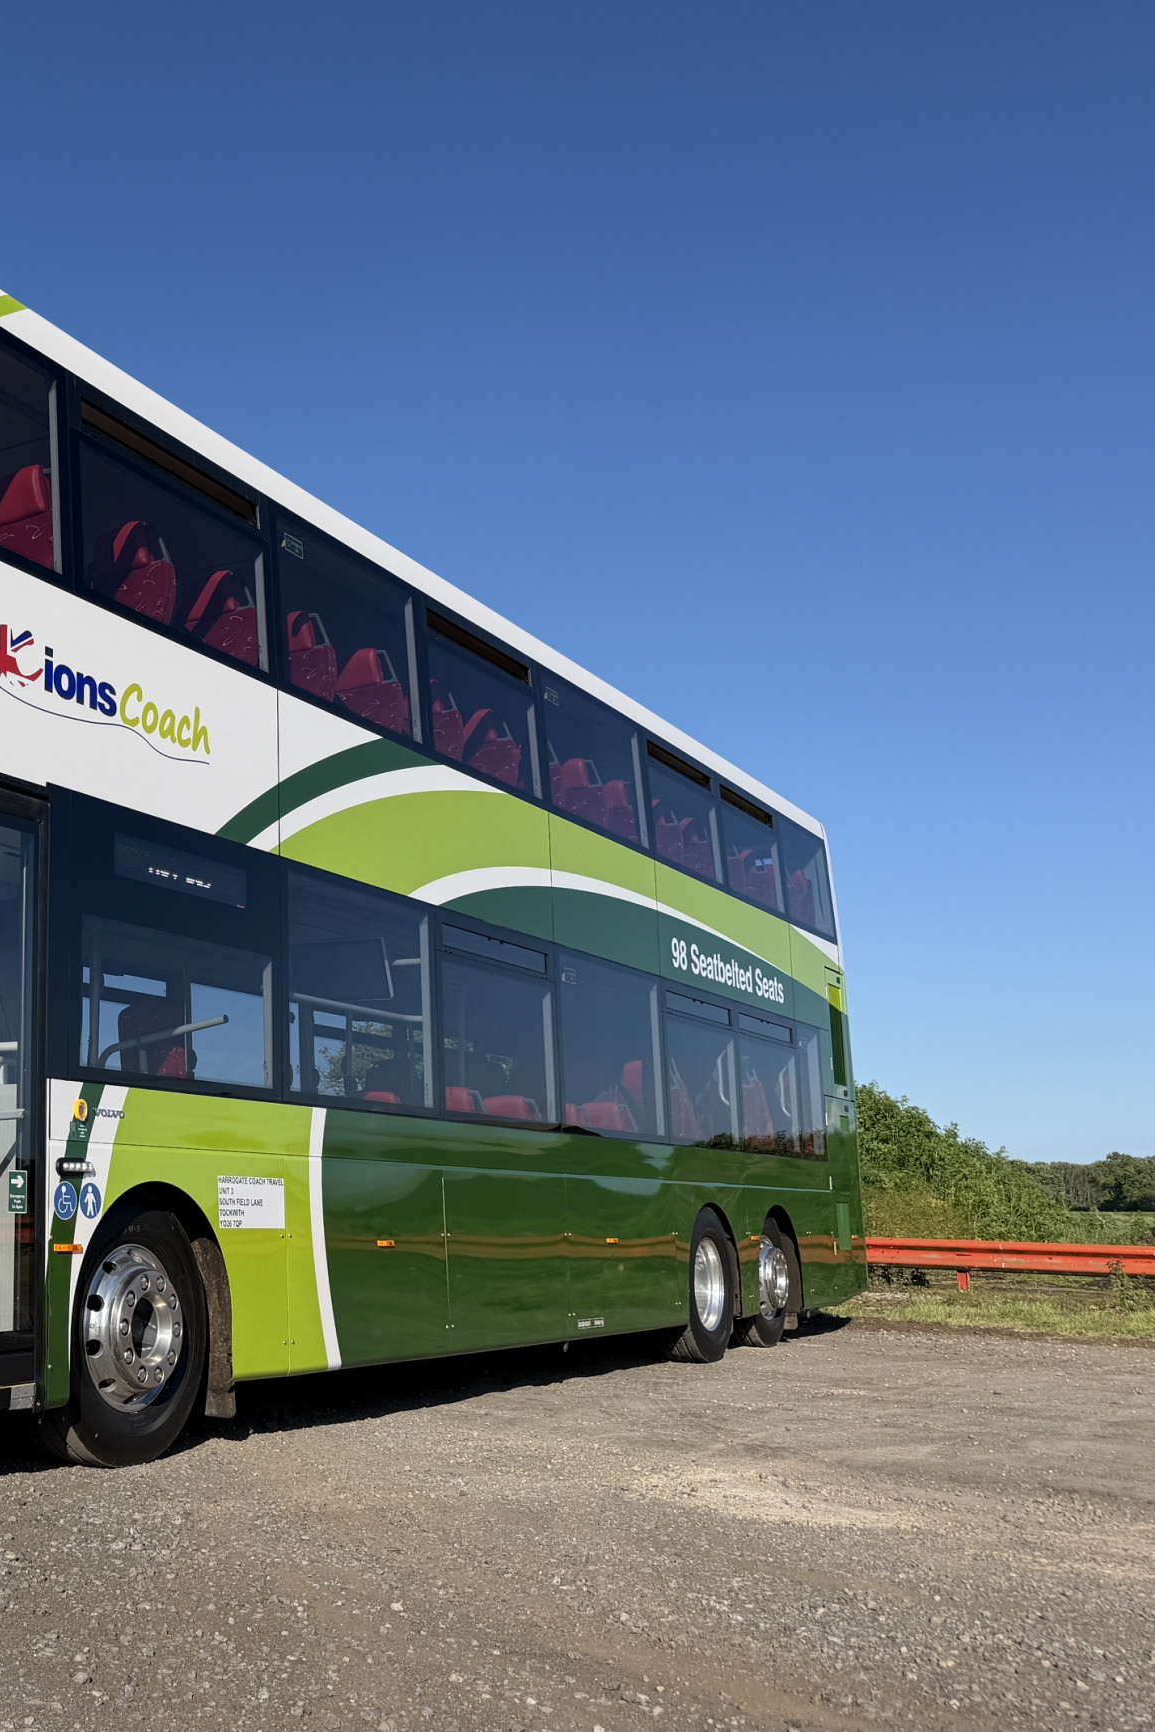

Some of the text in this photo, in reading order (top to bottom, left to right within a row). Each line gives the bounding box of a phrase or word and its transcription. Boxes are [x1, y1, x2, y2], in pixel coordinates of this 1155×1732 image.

[671, 937, 785, 1004] 98 Seatbelted Seats
[92, 1107, 125, 1119] VOLVO
[218, 1176, 284, 1186] HARROGATE COACH TRAVEL
[219, 1187, 230, 1195] UNIT
[219, 1198, 264, 1207] SOUTH FIELD LANE
[219, 1208, 245, 1217] TOCKWITH
[220, 1219, 232, 1228] YO26
